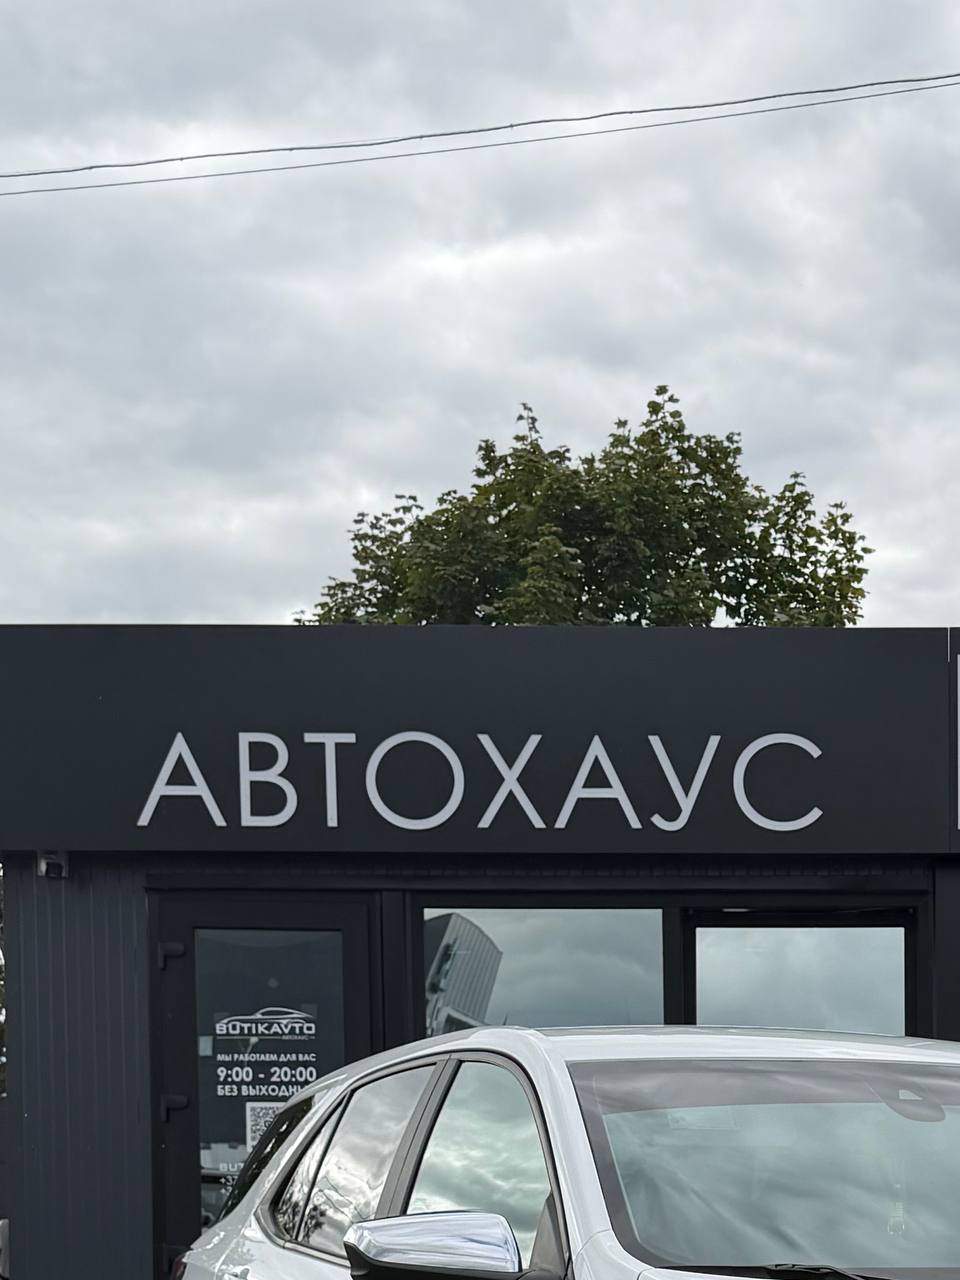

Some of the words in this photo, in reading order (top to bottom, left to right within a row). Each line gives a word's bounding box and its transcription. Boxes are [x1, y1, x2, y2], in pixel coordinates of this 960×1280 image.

[137, 731, 824, 832] АВТОХАУС
[215, 1023, 315, 1034] BUTIKAVTO
[216, 1054, 232, 1062] МЫ
[233, 1054, 278, 1062] РАБОТАЕМ
[279, 1054, 297, 1062] ДЛЯ
[298, 1054, 317, 1062] ВАС
[217, 1066, 253, 1082] 9:00
[270, 1066, 317, 1082] 20:00
[217, 1085, 238, 1096] БЕЗ
[241, 1085, 303, 1097] ВЫХОДН
